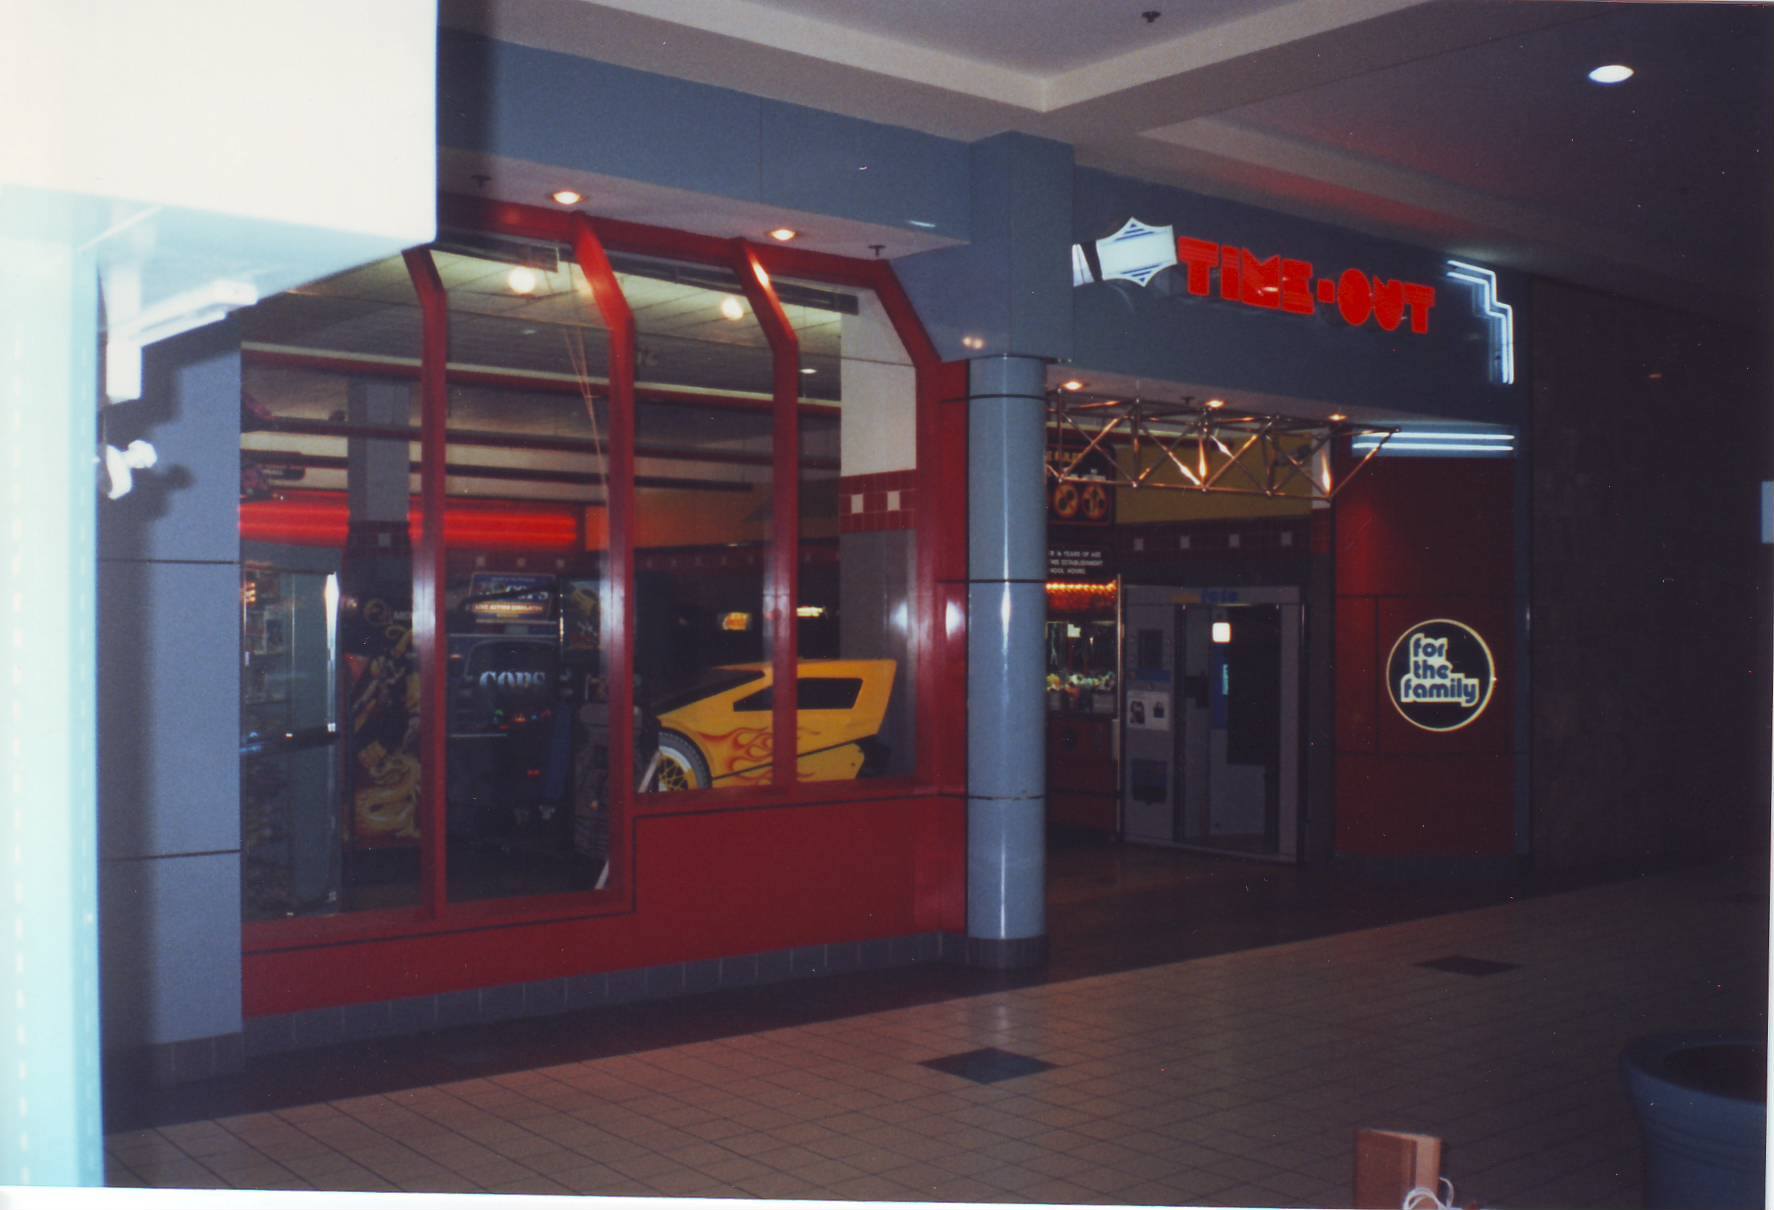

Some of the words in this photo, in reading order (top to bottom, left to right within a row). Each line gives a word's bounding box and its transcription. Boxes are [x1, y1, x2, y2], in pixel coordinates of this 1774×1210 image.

[1410, 634, 1447, 659] for
[1411, 659, 1451, 680] the
[1402, 676, 1478, 705] family
